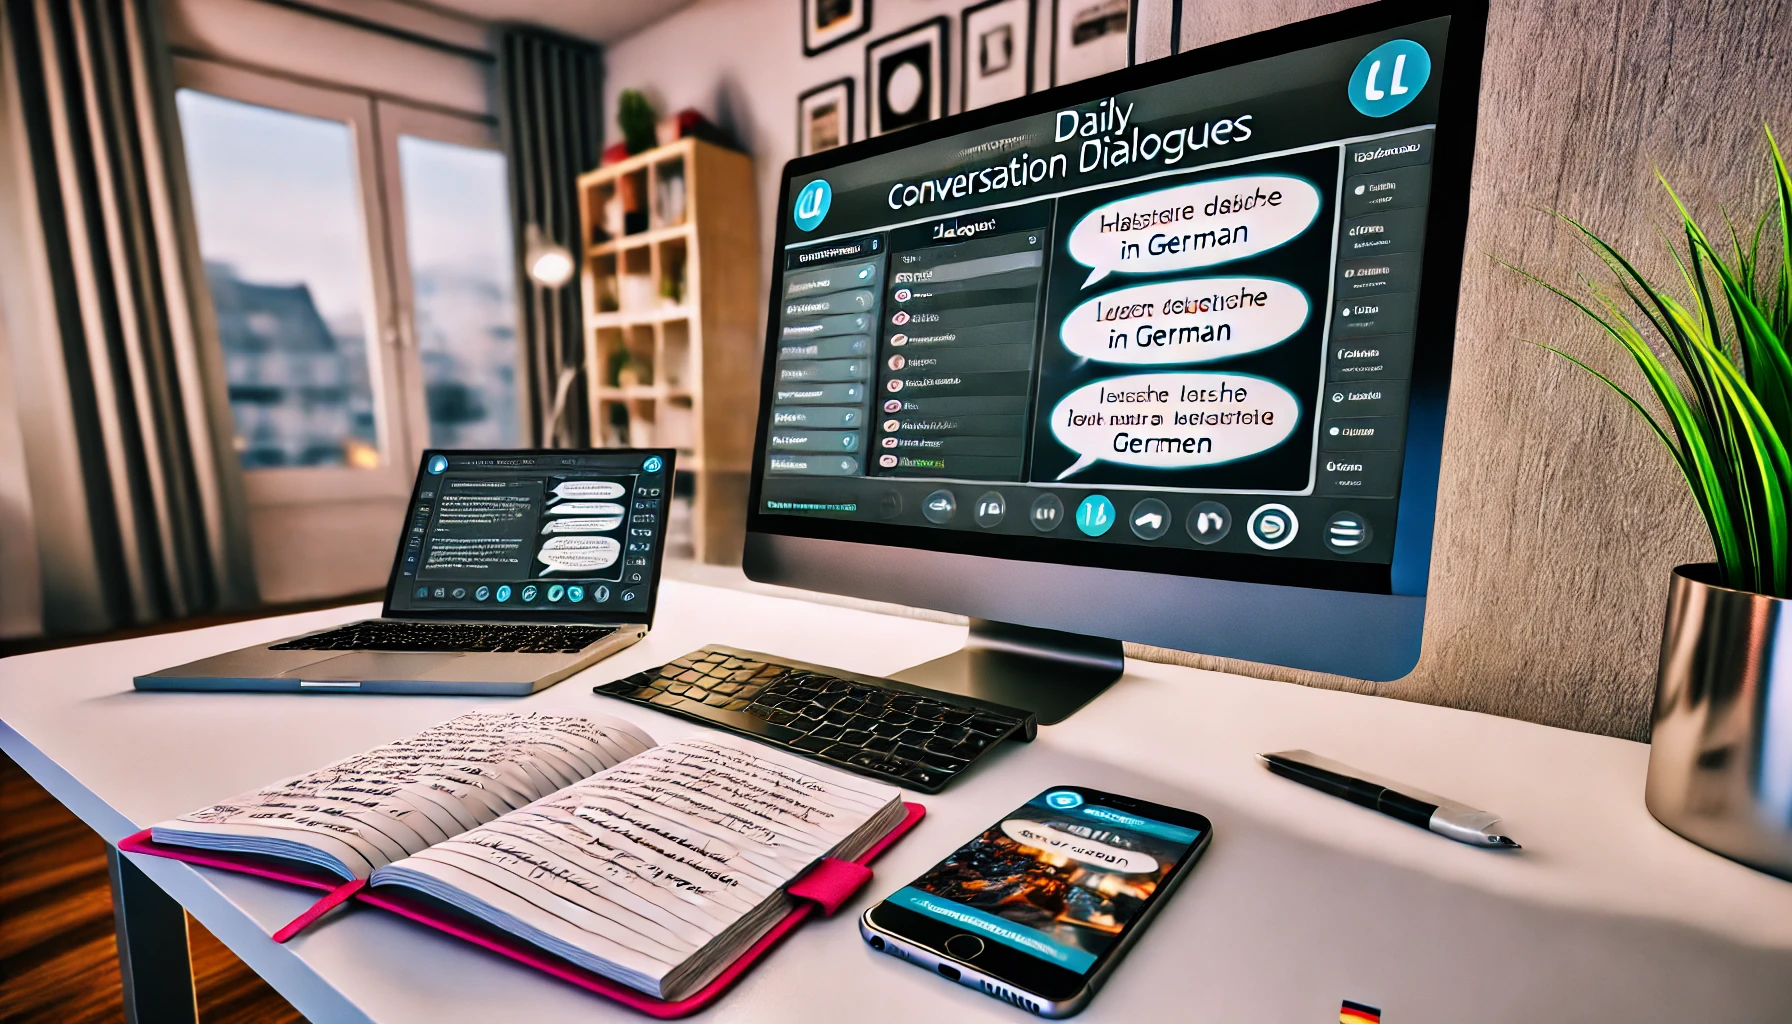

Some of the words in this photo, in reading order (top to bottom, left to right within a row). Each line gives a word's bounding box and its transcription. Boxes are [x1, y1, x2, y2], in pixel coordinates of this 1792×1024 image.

[1054, 97, 1134, 143] Daily
[887, 153, 1068, 210] Conversation
[1079, 114, 1254, 174] Dialogues
[1121, 240, 1140, 260] in
[1148, 225, 1248, 255] German
[1108, 329, 1128, 349] in
[1136, 323, 1231, 348] German
